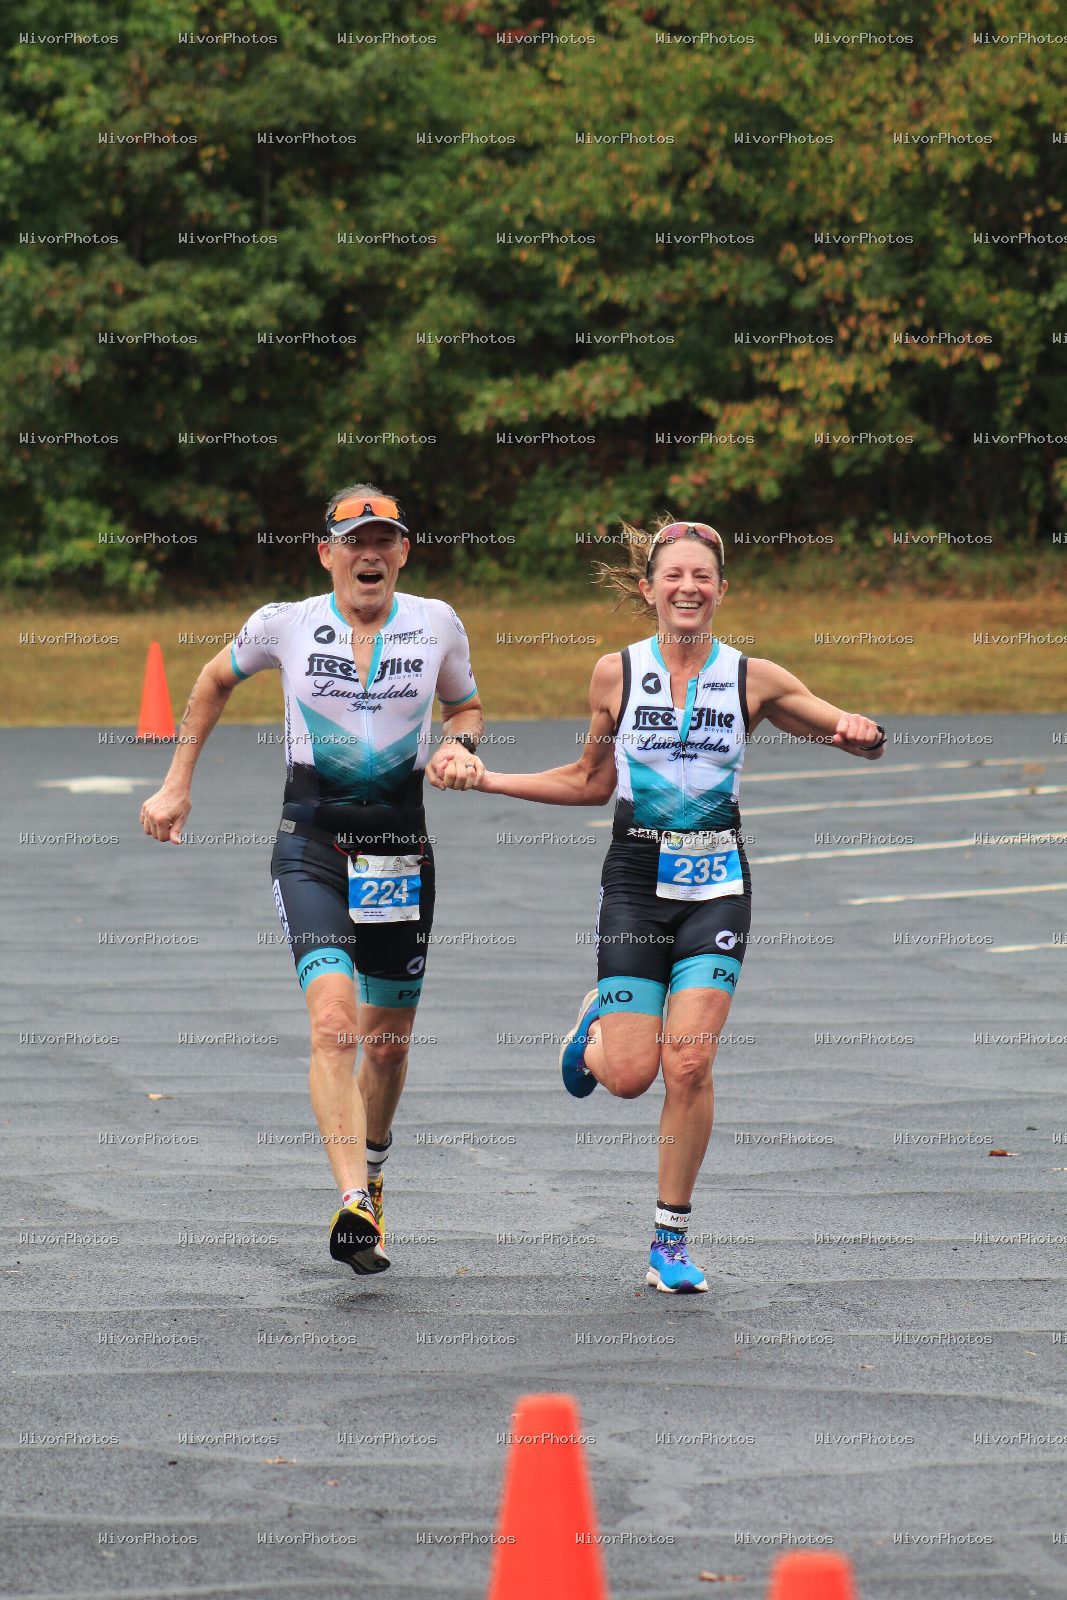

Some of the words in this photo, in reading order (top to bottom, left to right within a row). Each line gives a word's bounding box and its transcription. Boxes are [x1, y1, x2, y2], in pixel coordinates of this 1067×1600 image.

[638, 828, 658, 836] PTS
[673, 856, 728, 883] 235
[361, 878, 410, 906] 224
